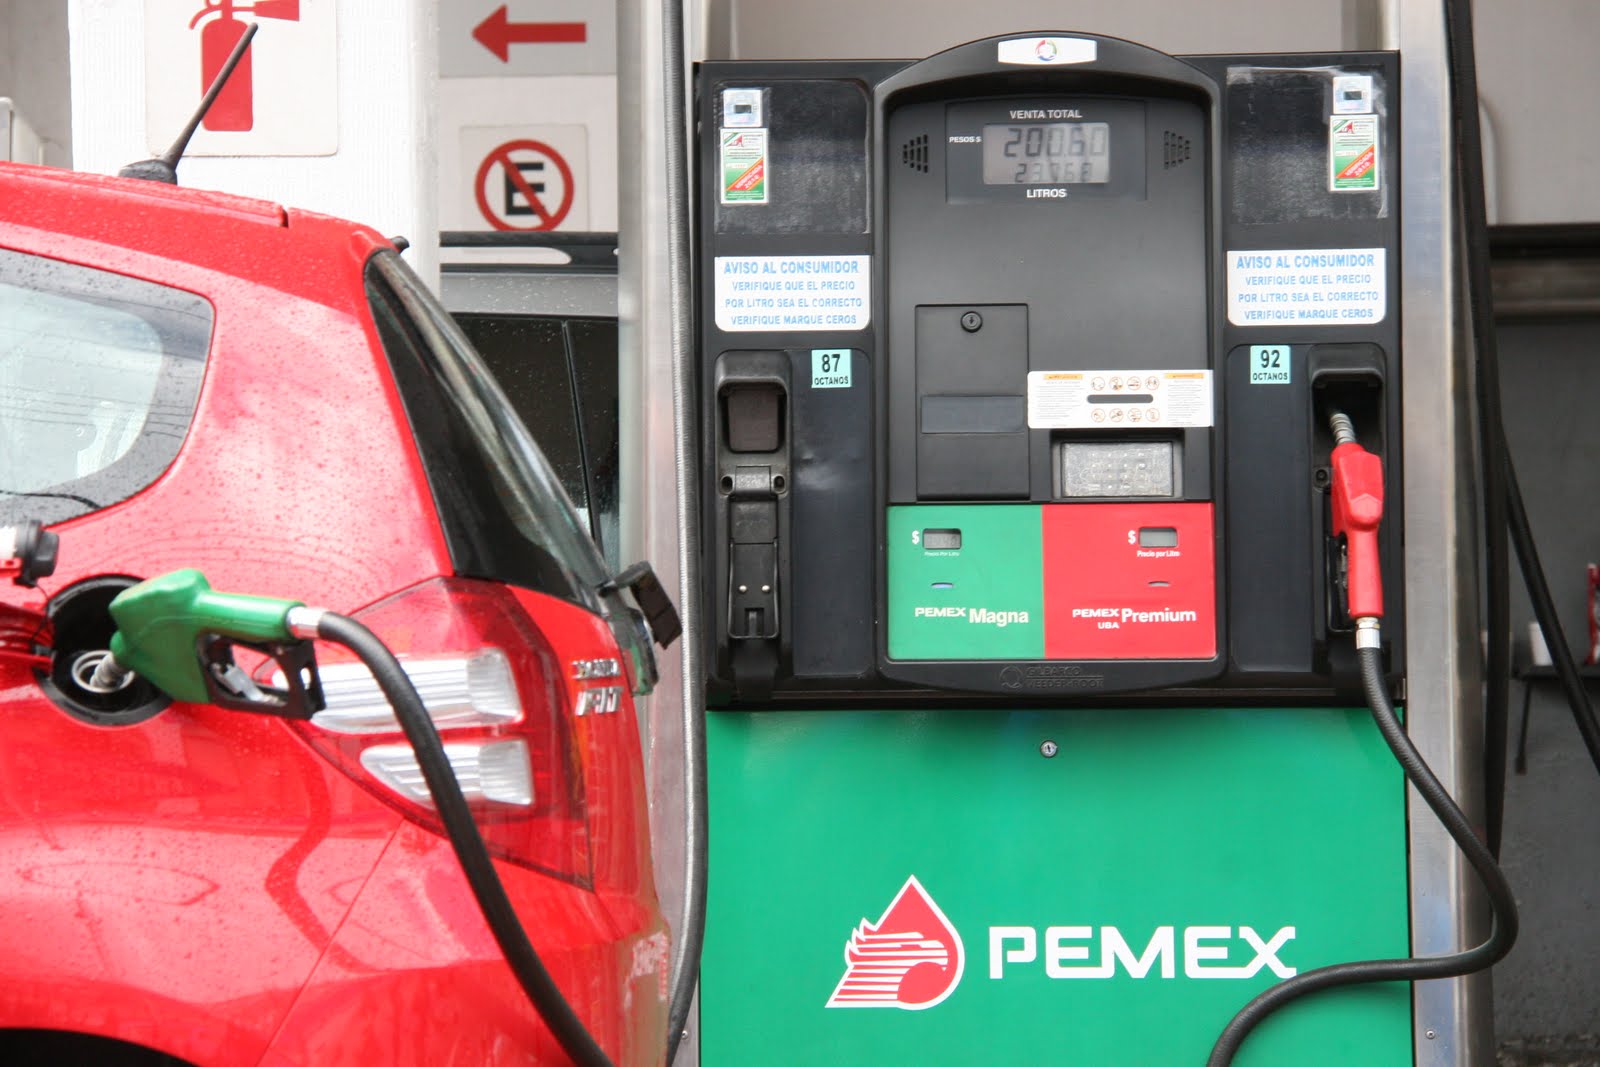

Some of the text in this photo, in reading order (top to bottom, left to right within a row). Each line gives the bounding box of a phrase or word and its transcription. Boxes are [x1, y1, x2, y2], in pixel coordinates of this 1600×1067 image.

[1009, 109, 1083, 119] VENTA TOTAL
[505, 162, 545, 216] E
[1026, 189, 1068, 198] LITROS
[723, 260, 859, 274] AVISO AL CONSUMIDOR
[1236, 254, 1375, 269] AVISO AL CONSUMIDOR
[732, 280, 855, 291] VERIFIQUE QUE EL PRECIO
[1245, 274, 1371, 286] VERIFIQUE QUE EL PRECIO
[725, 297, 862, 308] POR LITRO SEA EL CORRECTO
[1238, 291, 1379, 303] POR LITRO SEA EL CORRECTO
[731, 314, 857, 325] VERIFIQUE MARQUE CEROS
[1244, 308, 1374, 320] VERIFIQUE MARQUE CEROS
[821, 353, 841, 373] 87
[1260, 349, 1281, 368] 92
[813, 375, 850, 386] OCTANOS
[1252, 371, 1288, 381] OCTANOS
[911, 530, 920, 545] $
[1127, 530, 1137, 544] $
[915, 607, 1029, 627] PEMEX Magna
[1072, 607, 1196, 623] PEMEX Premium
[989, 926, 1297, 980] PEMEX
